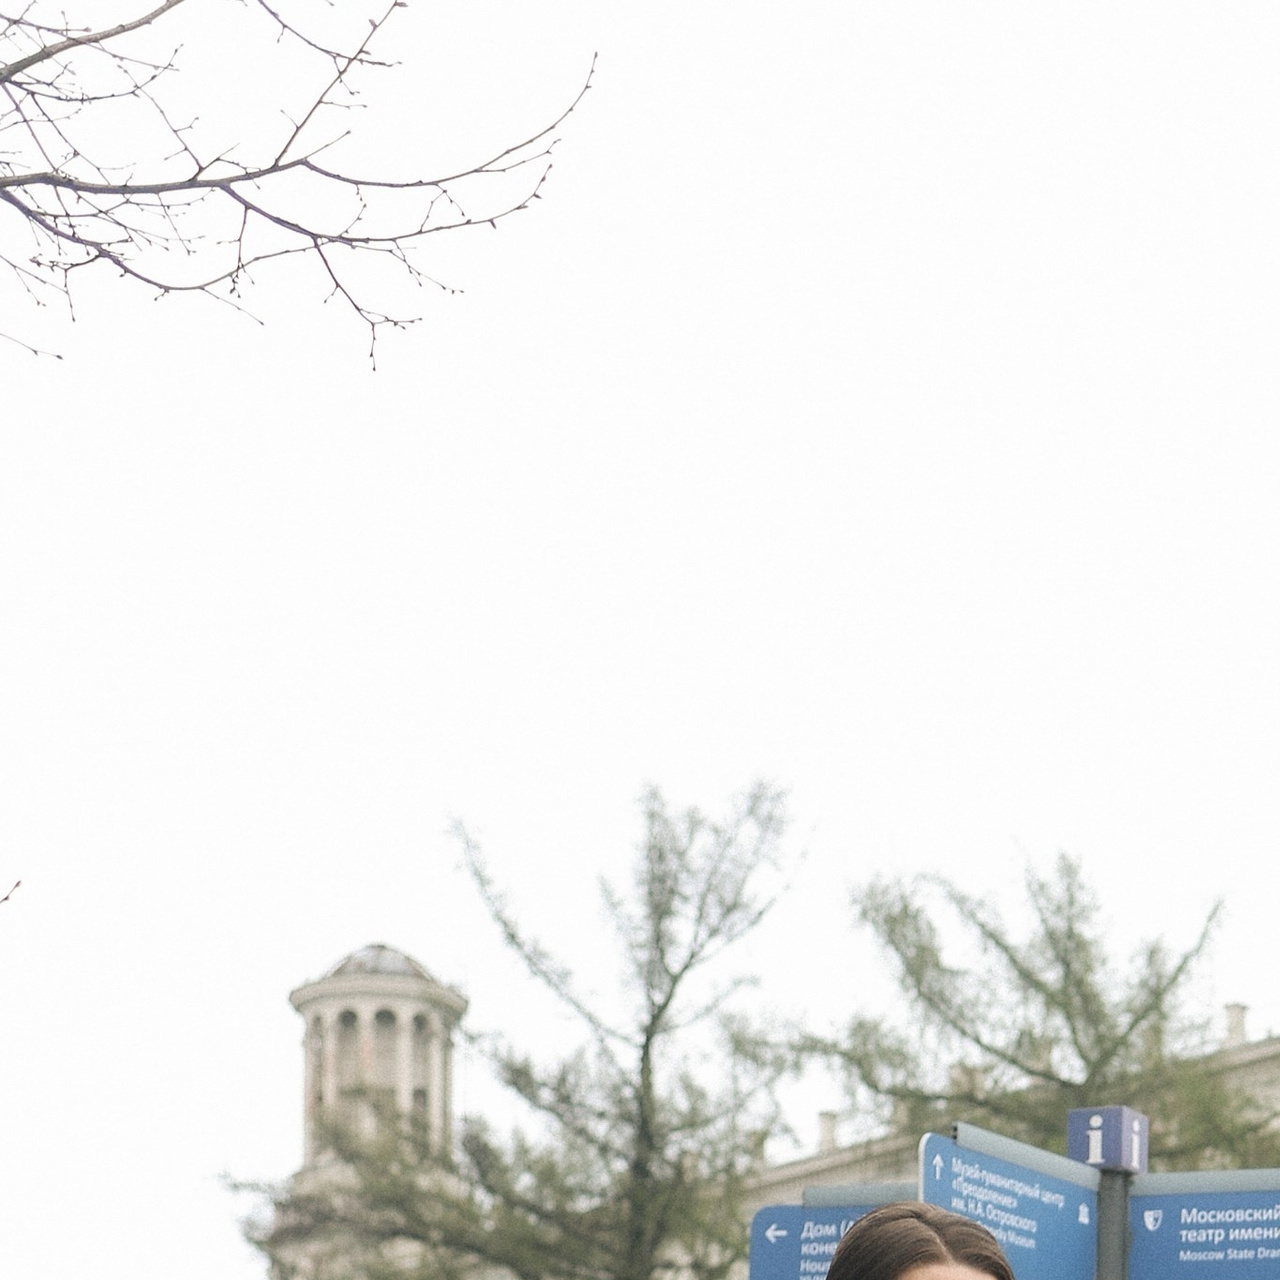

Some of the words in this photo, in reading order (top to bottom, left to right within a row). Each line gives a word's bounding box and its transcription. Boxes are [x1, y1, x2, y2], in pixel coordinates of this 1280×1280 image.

[986, 1204, 1037, 1233] Островского
[801, 1220, 839, 1241] Дом
[1179, 1228, 1225, 1245] театр
[801, 1241, 839, 1256] коне
[1179, 1249, 1225, 1261] Moscow
[1226, 1247, 1256, 1260] State
